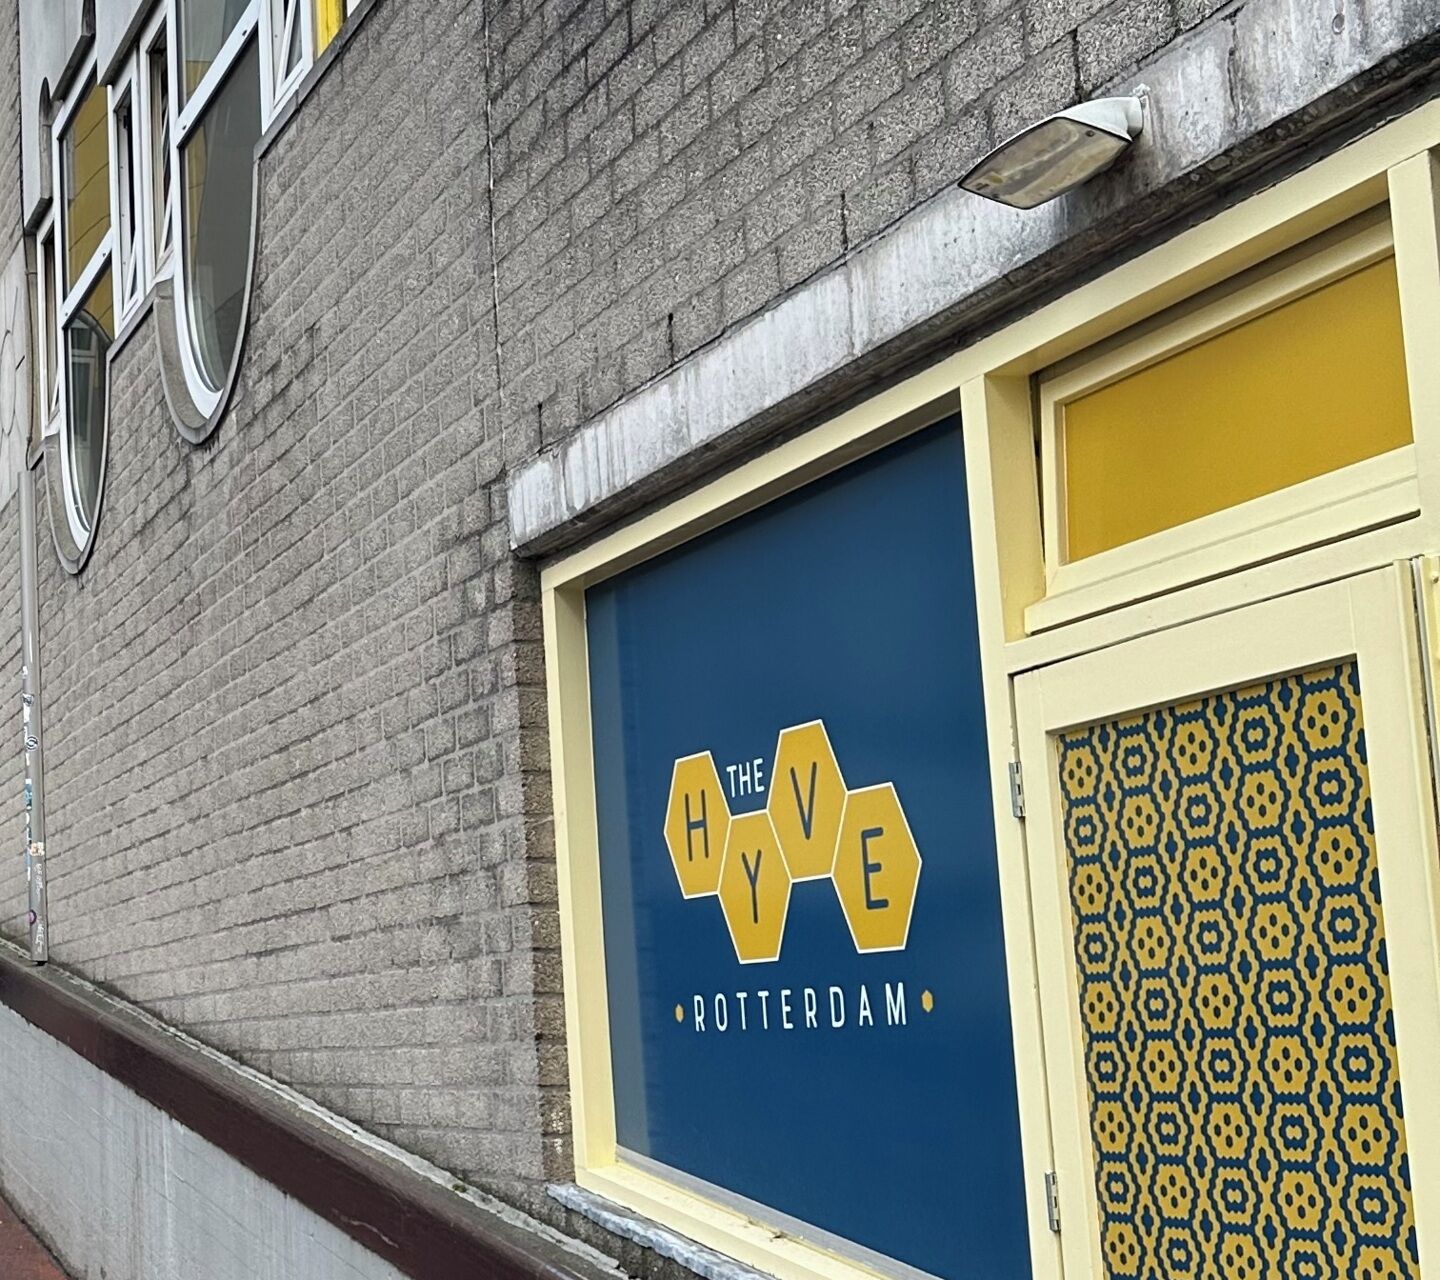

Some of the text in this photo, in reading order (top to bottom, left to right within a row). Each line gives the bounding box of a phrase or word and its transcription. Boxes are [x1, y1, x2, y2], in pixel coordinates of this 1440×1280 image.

[726, 758, 765, 798] THE
[684, 761, 890, 925] HYVE
[693, 982, 907, 1032] ROTTERDAM
